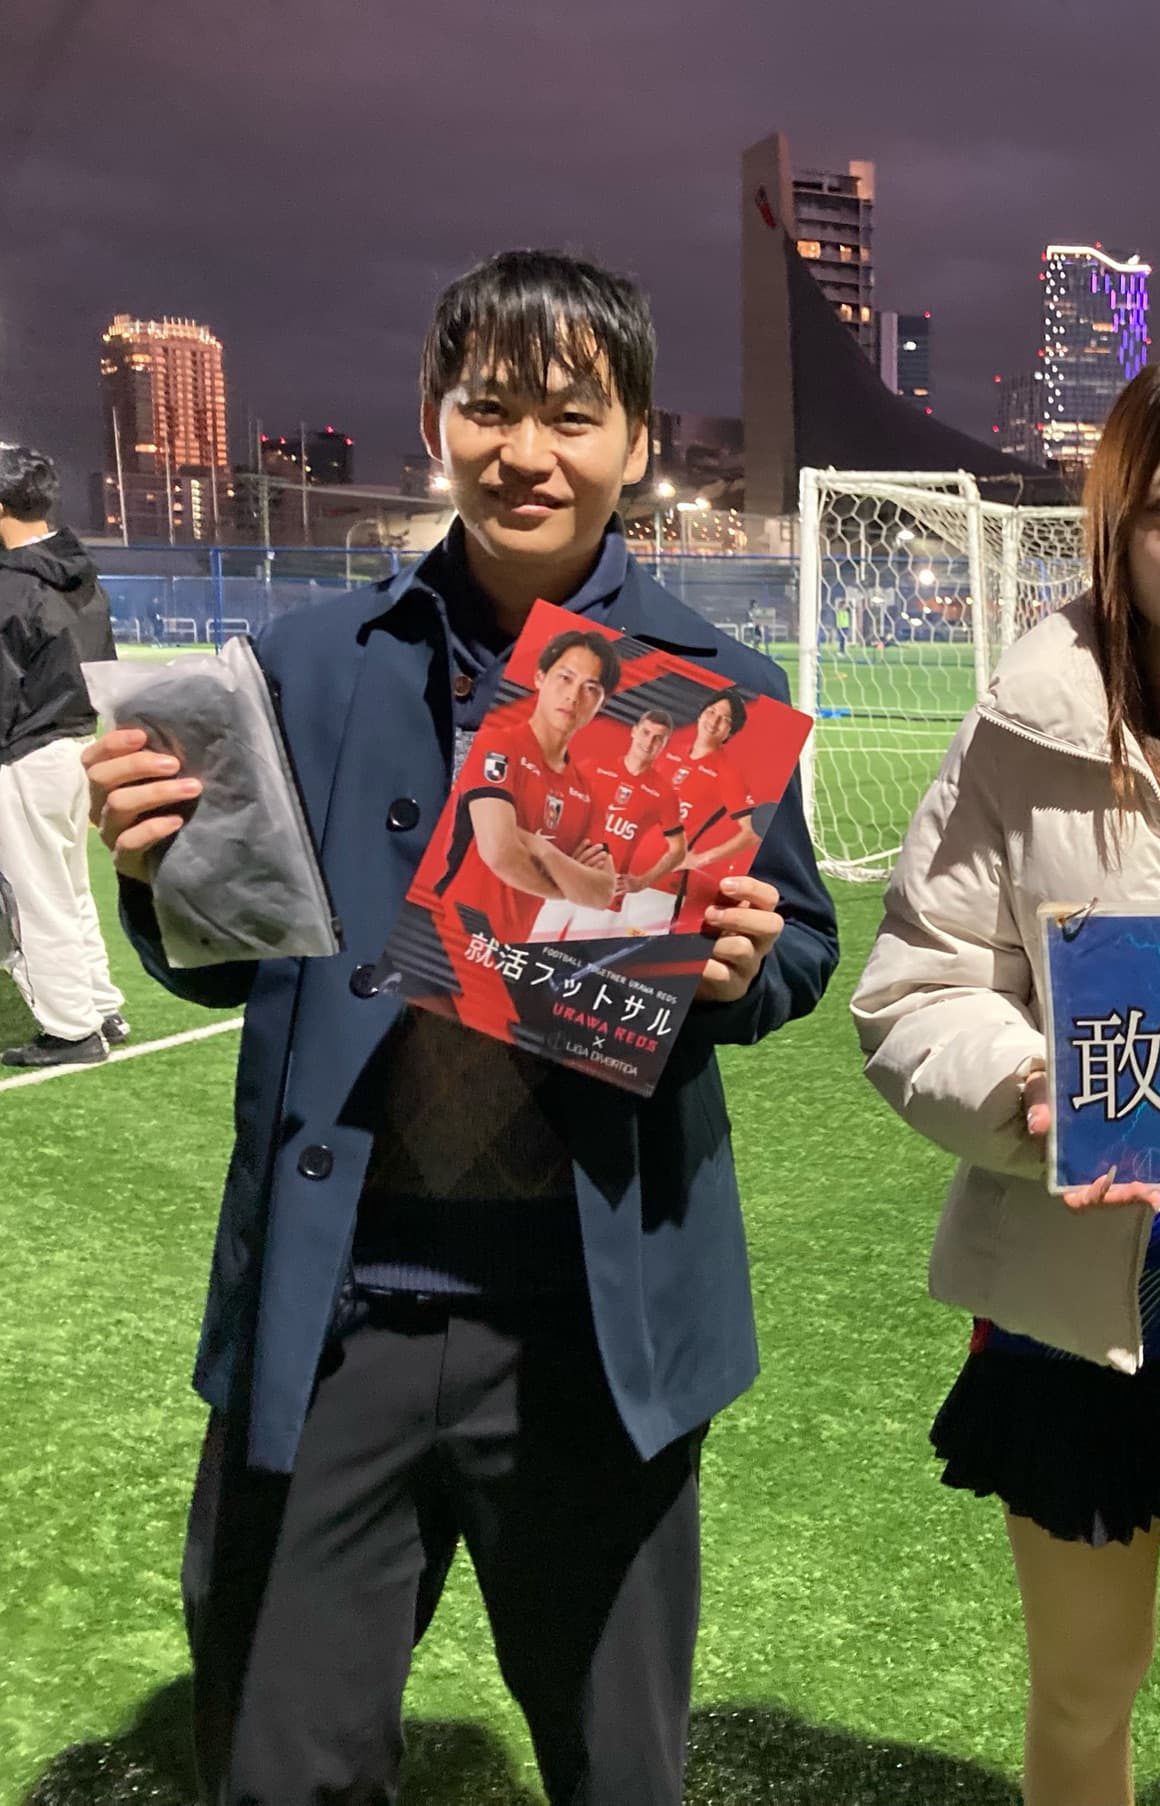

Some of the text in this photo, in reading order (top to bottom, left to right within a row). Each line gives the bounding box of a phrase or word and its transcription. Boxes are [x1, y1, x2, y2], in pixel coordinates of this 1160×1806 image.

[463, 931, 673, 1037] 就活フットサル
[542, 946, 582, 968] FOOTBALL
[588, 963, 628, 985] GETHER
[552, 1001, 659, 1053] URAWA REDS
